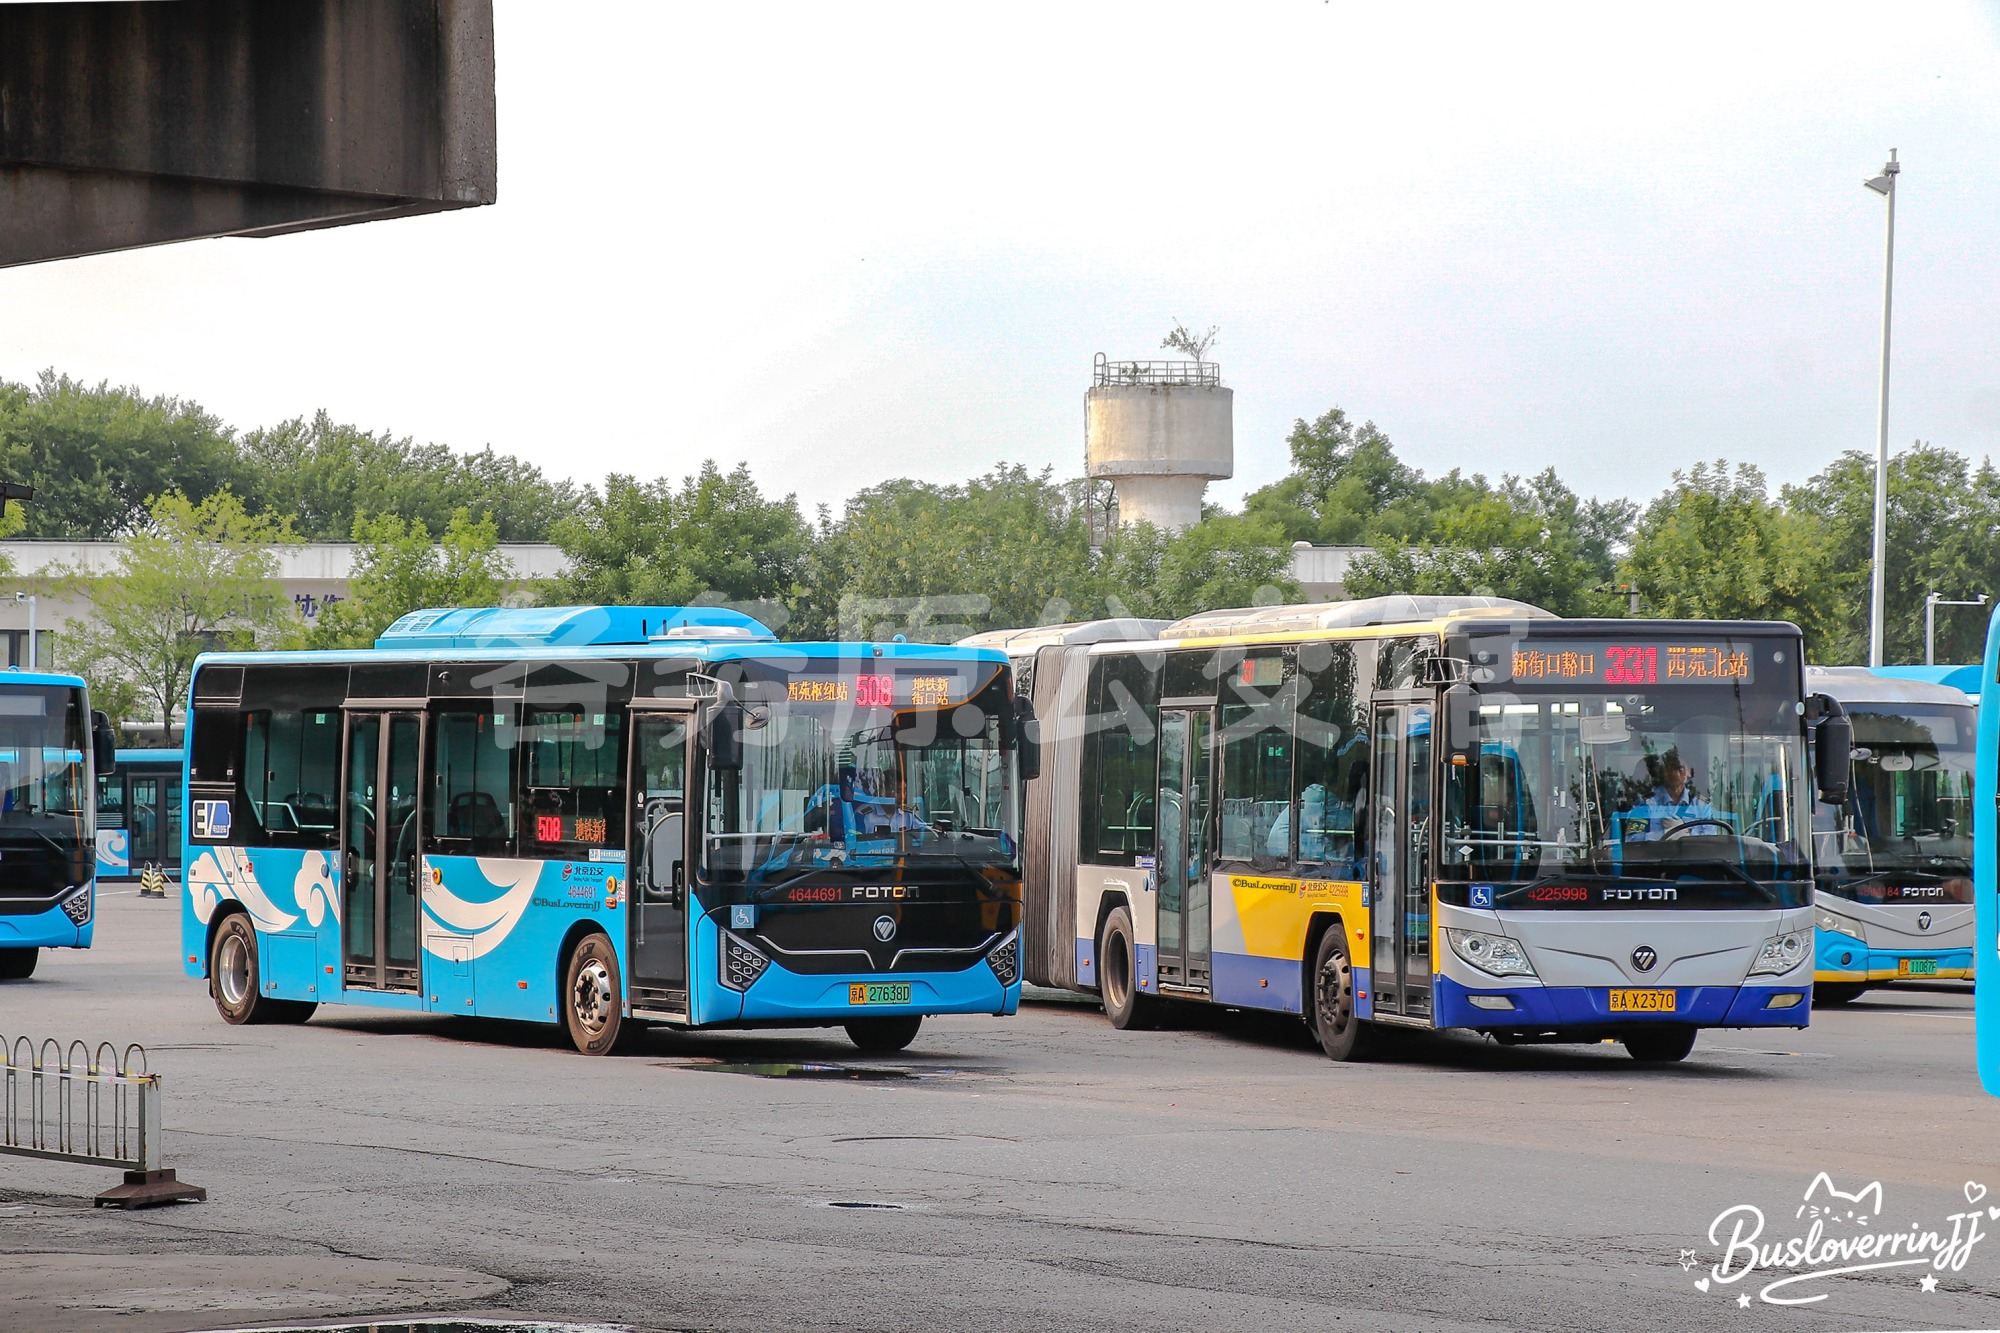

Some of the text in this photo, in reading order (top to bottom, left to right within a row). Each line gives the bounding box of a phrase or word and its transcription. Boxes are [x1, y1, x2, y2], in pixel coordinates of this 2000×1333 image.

[1511, 645, 1749, 683] 新街口豁口 331 西苑北站
[786, 674, 949, 707] 西苑枢纽站 508 地铁新
[911, 691, 949, 706] 街口站
[537, 815, 562, 842] 508
[574, 865, 604, 876] 北京公交
[567, 885, 597, 899] 4644691
[788, 886, 920, 901] 4644691 FOTON
[1528, 887, 1678, 901] 4225998 FOTON
[1902, 887, 1944, 897] FOTON
